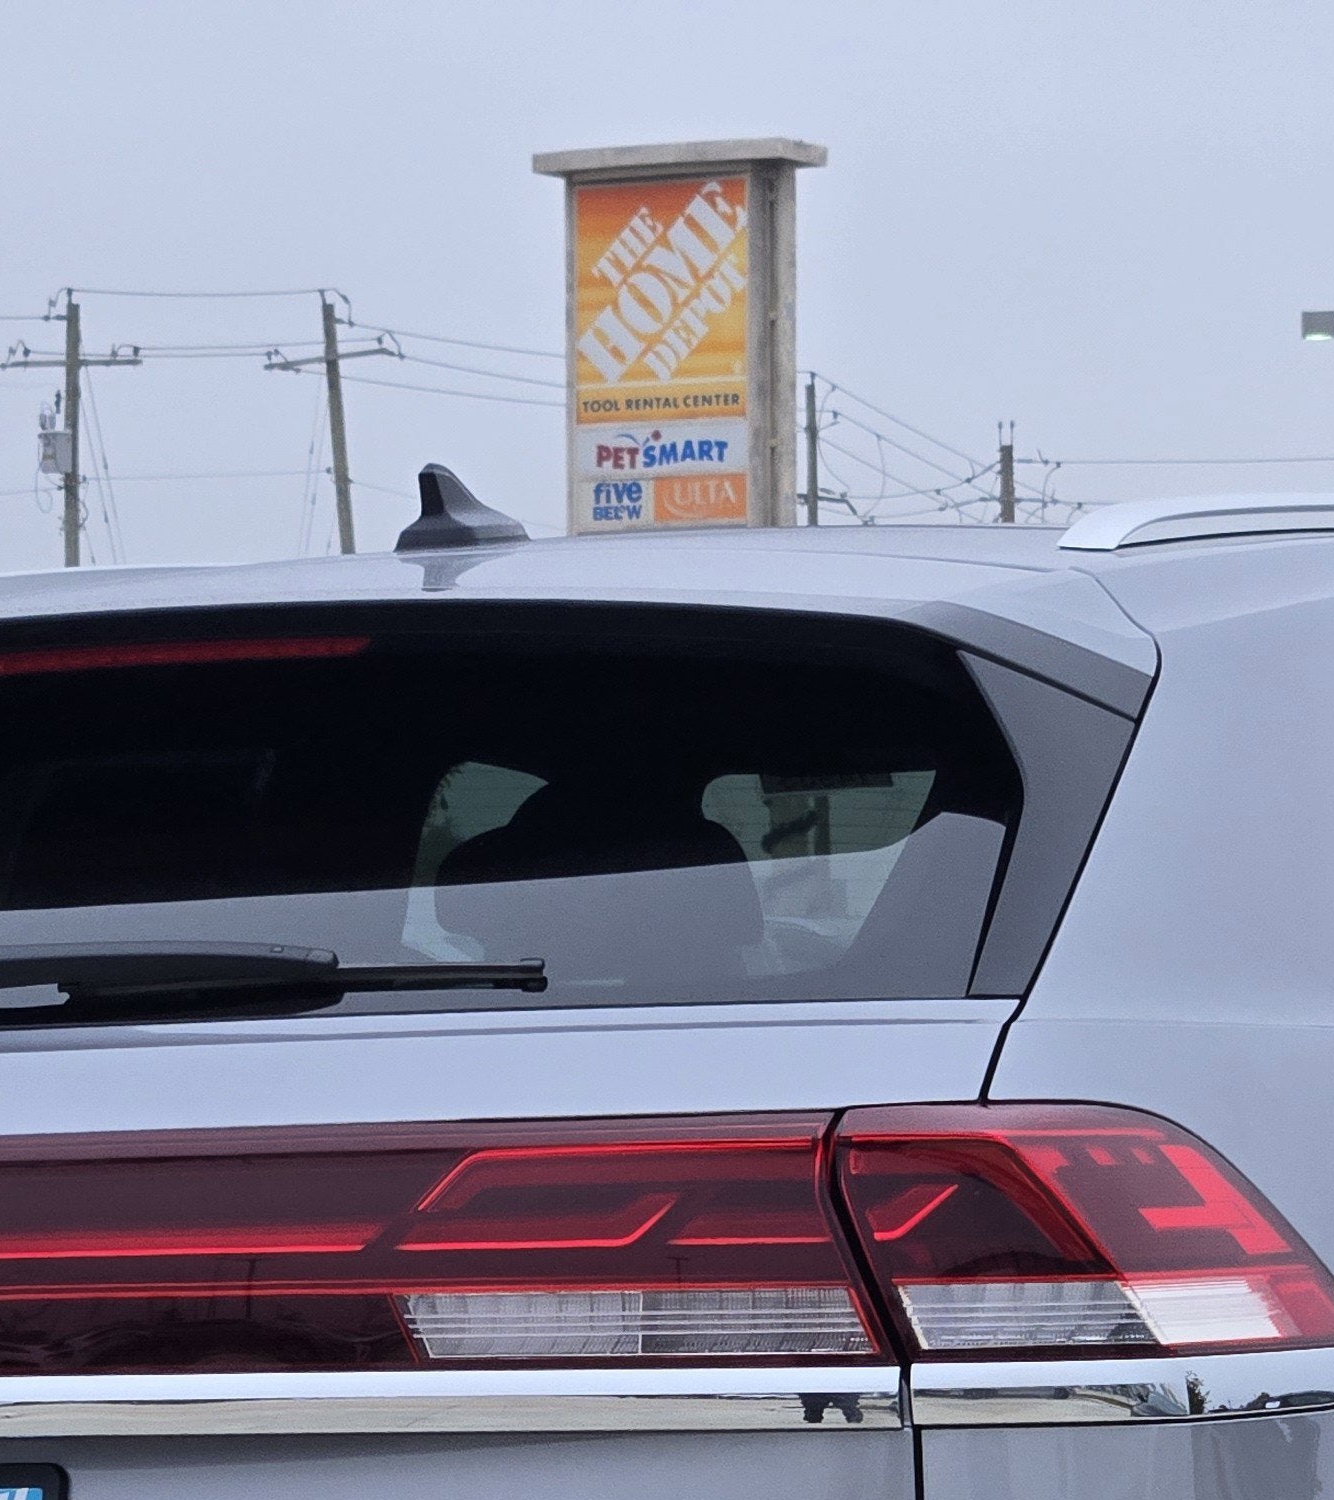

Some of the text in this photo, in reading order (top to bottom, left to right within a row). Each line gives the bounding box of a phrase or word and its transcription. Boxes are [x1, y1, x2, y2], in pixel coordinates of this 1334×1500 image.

[591, 206, 664, 288] THE
[576, 181, 749, 384] HOME
[642, 253, 749, 383] DEPOT
[582, 393, 740, 413] TOOL RENTAL CENTER
[593, 481, 643, 505] five
[673, 479, 736, 505] ULTA
